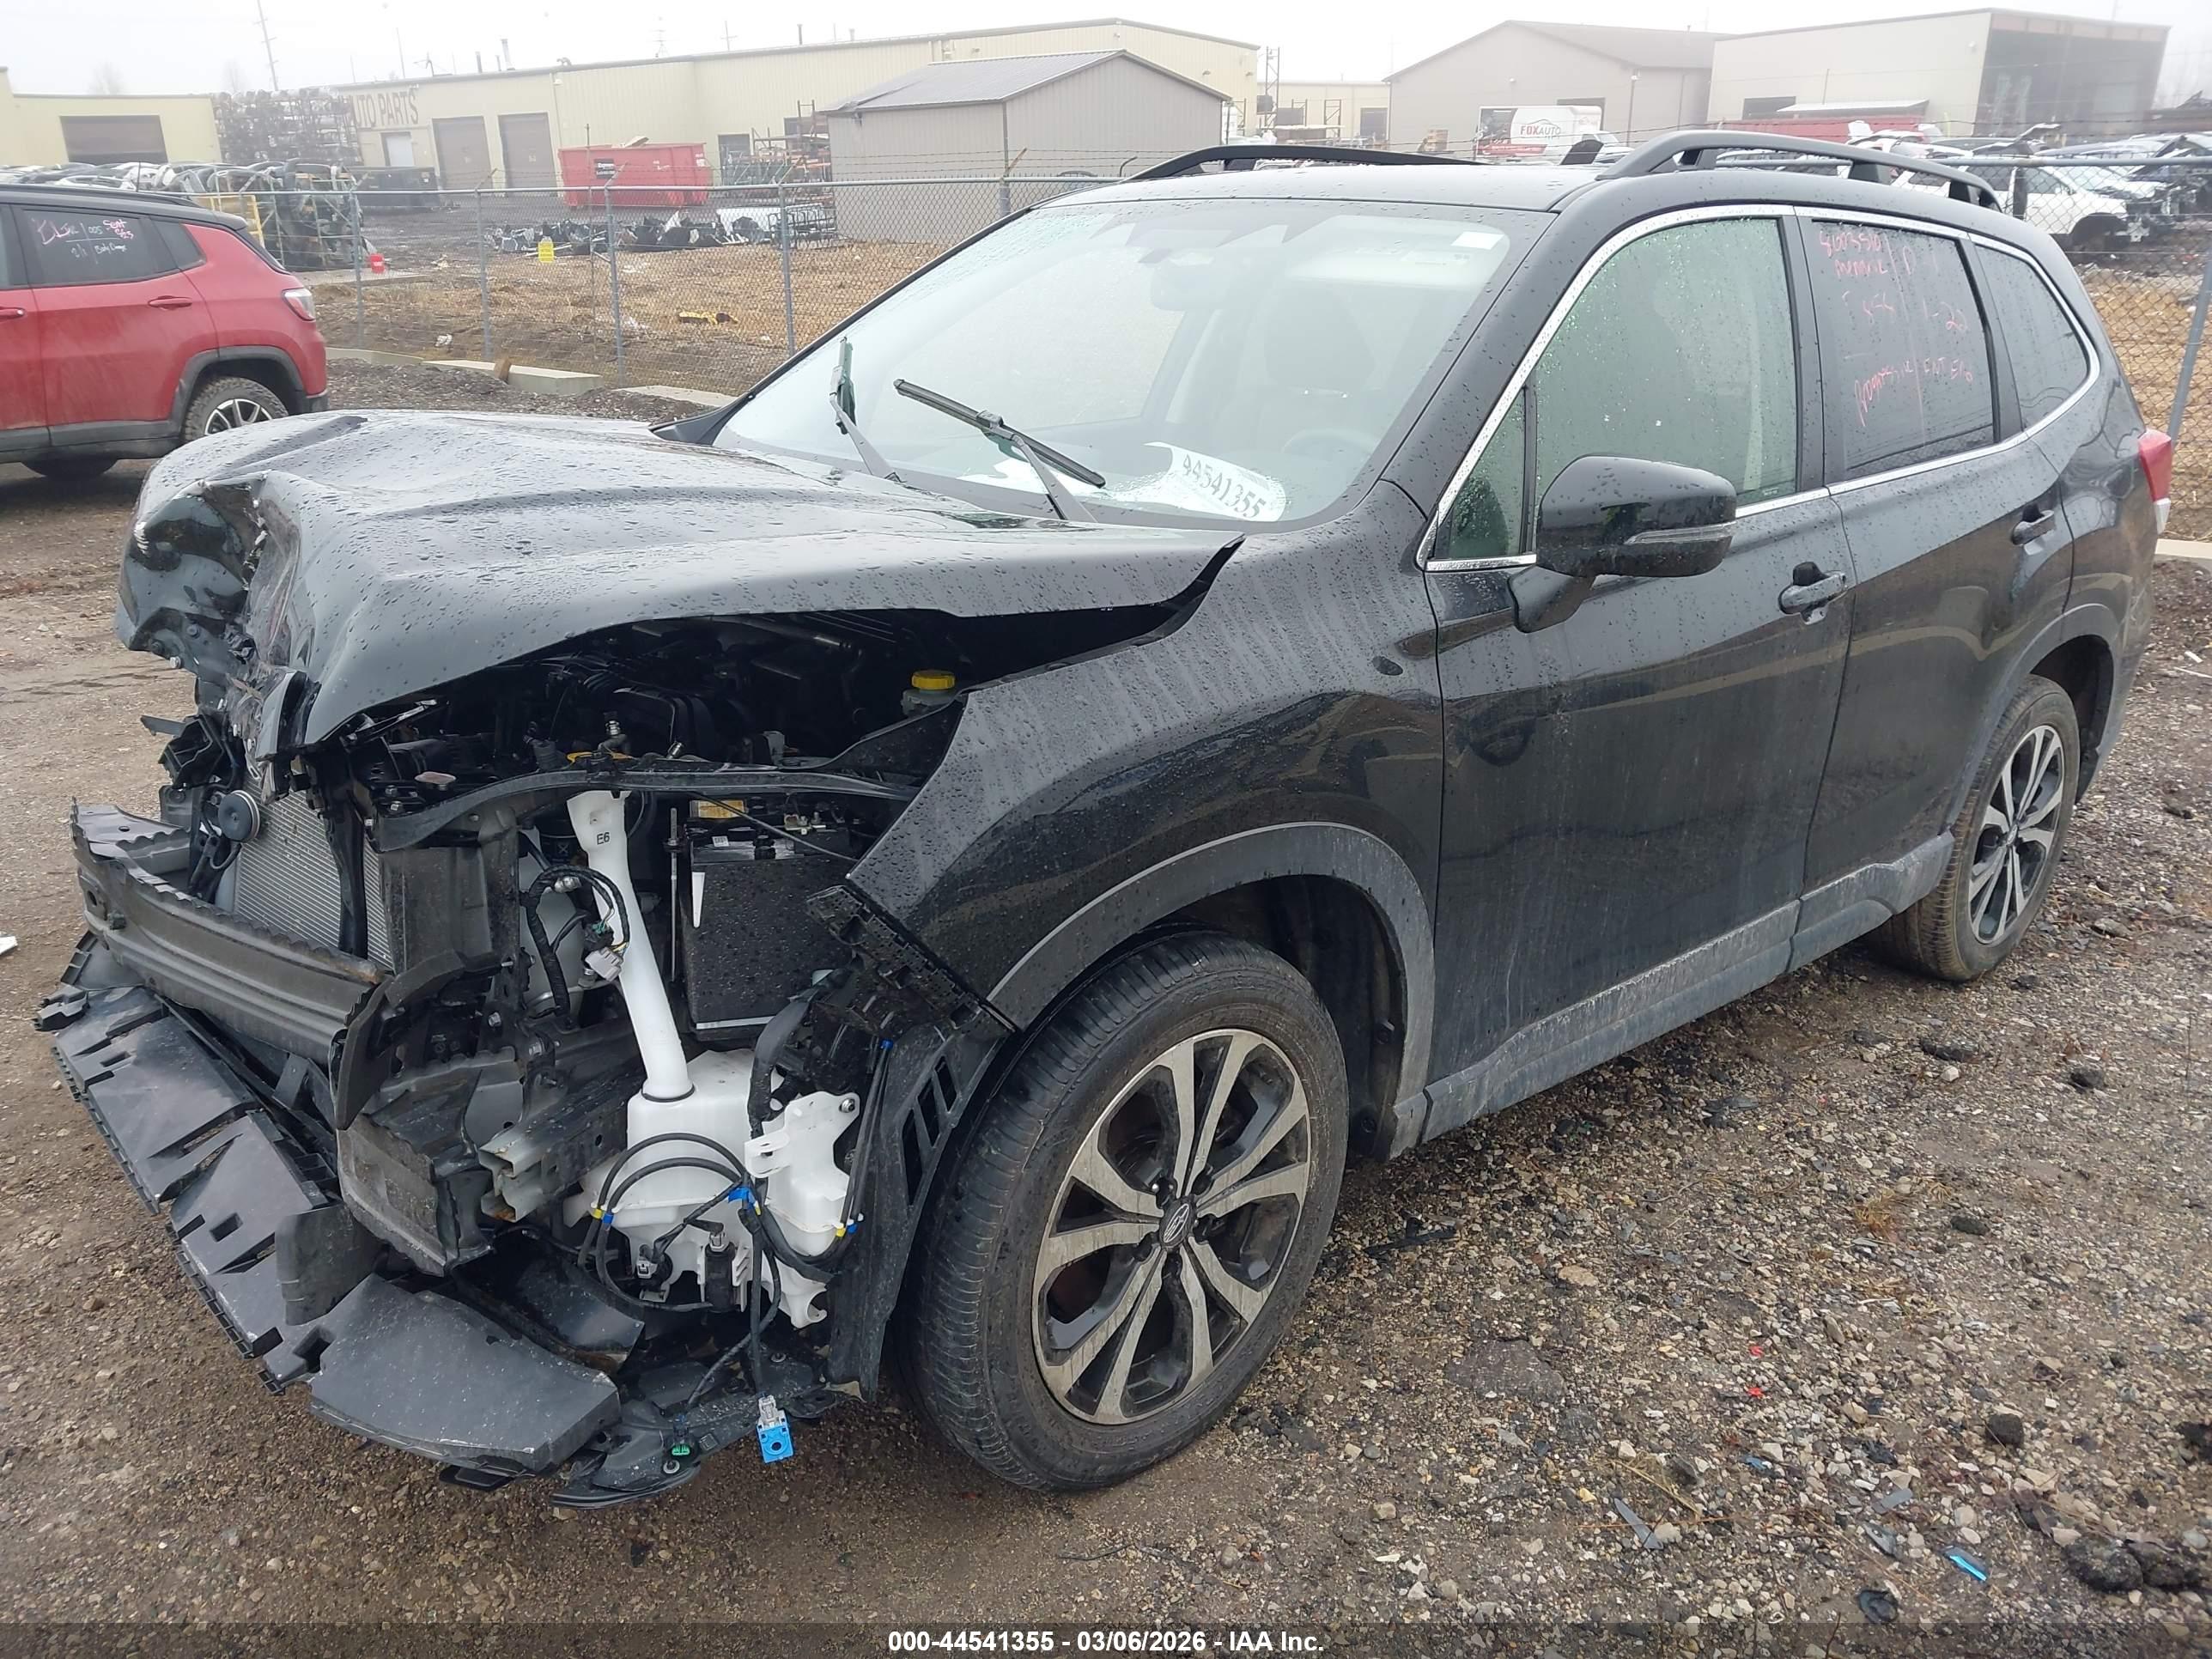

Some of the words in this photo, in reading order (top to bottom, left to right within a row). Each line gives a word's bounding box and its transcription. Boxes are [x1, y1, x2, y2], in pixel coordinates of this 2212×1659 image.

[349, 94, 377, 127] UTO
[378, 88, 419, 127] PARTS
[597, 831, 611, 845] E6
